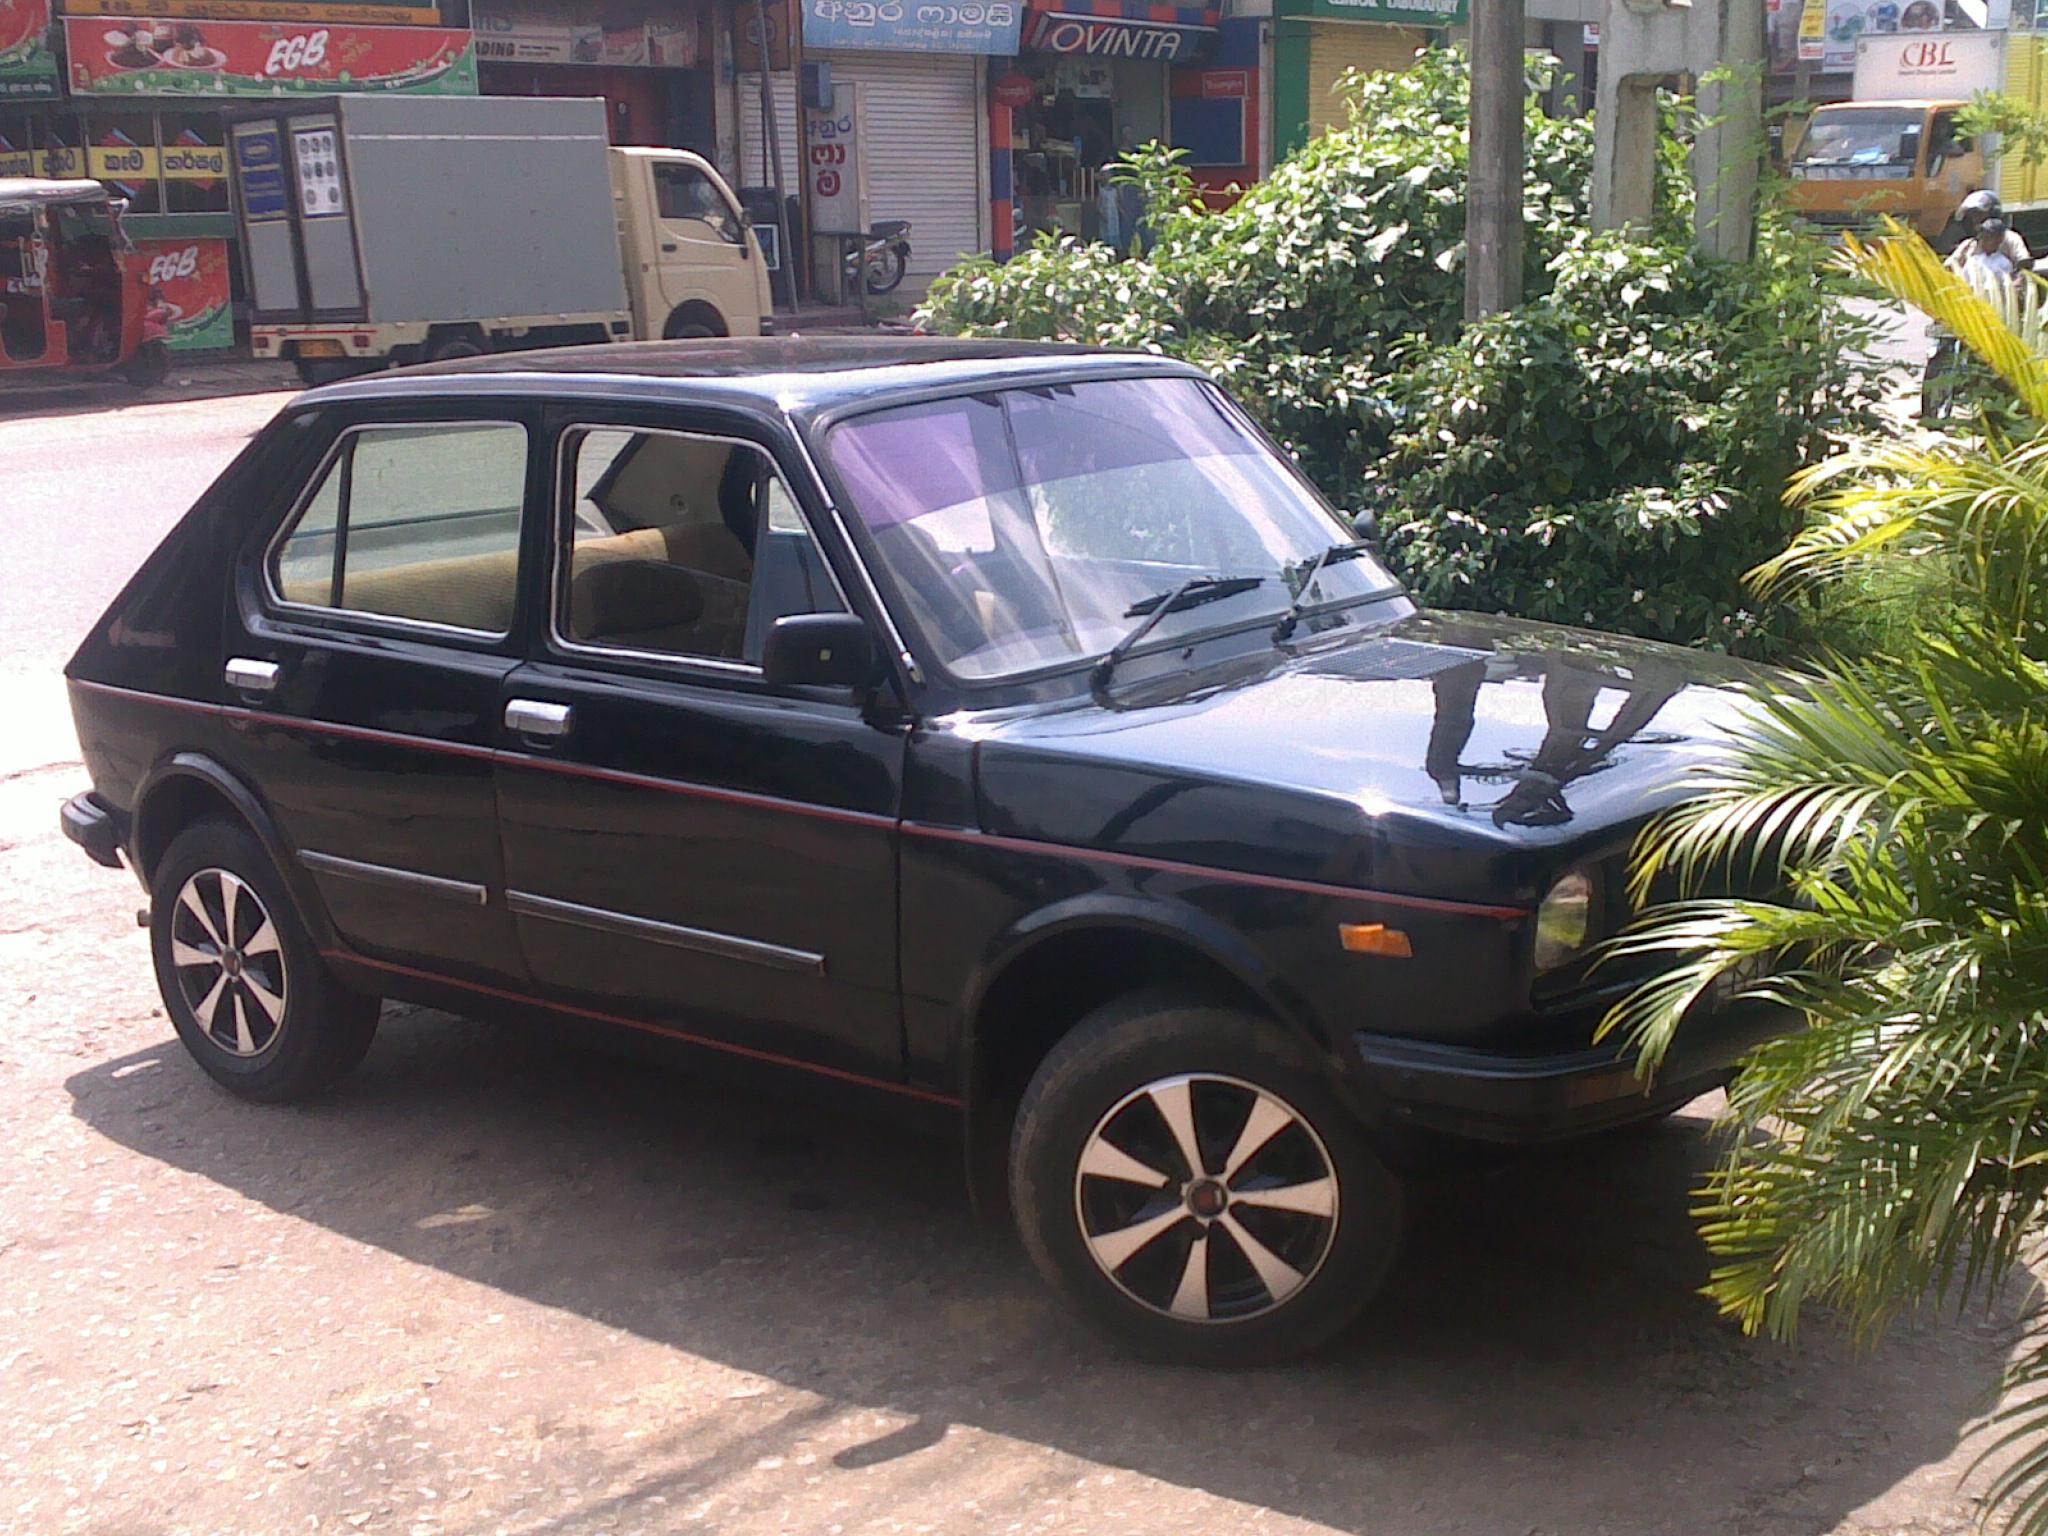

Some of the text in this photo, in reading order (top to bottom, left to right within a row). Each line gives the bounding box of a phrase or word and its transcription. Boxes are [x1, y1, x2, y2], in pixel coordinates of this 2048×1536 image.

[264, 29, 329, 75] EGB
[1051, 22, 1182, 60] OVINTA
[1900, 40, 1955, 67] CBL
[149, 244, 198, 285] EGB
